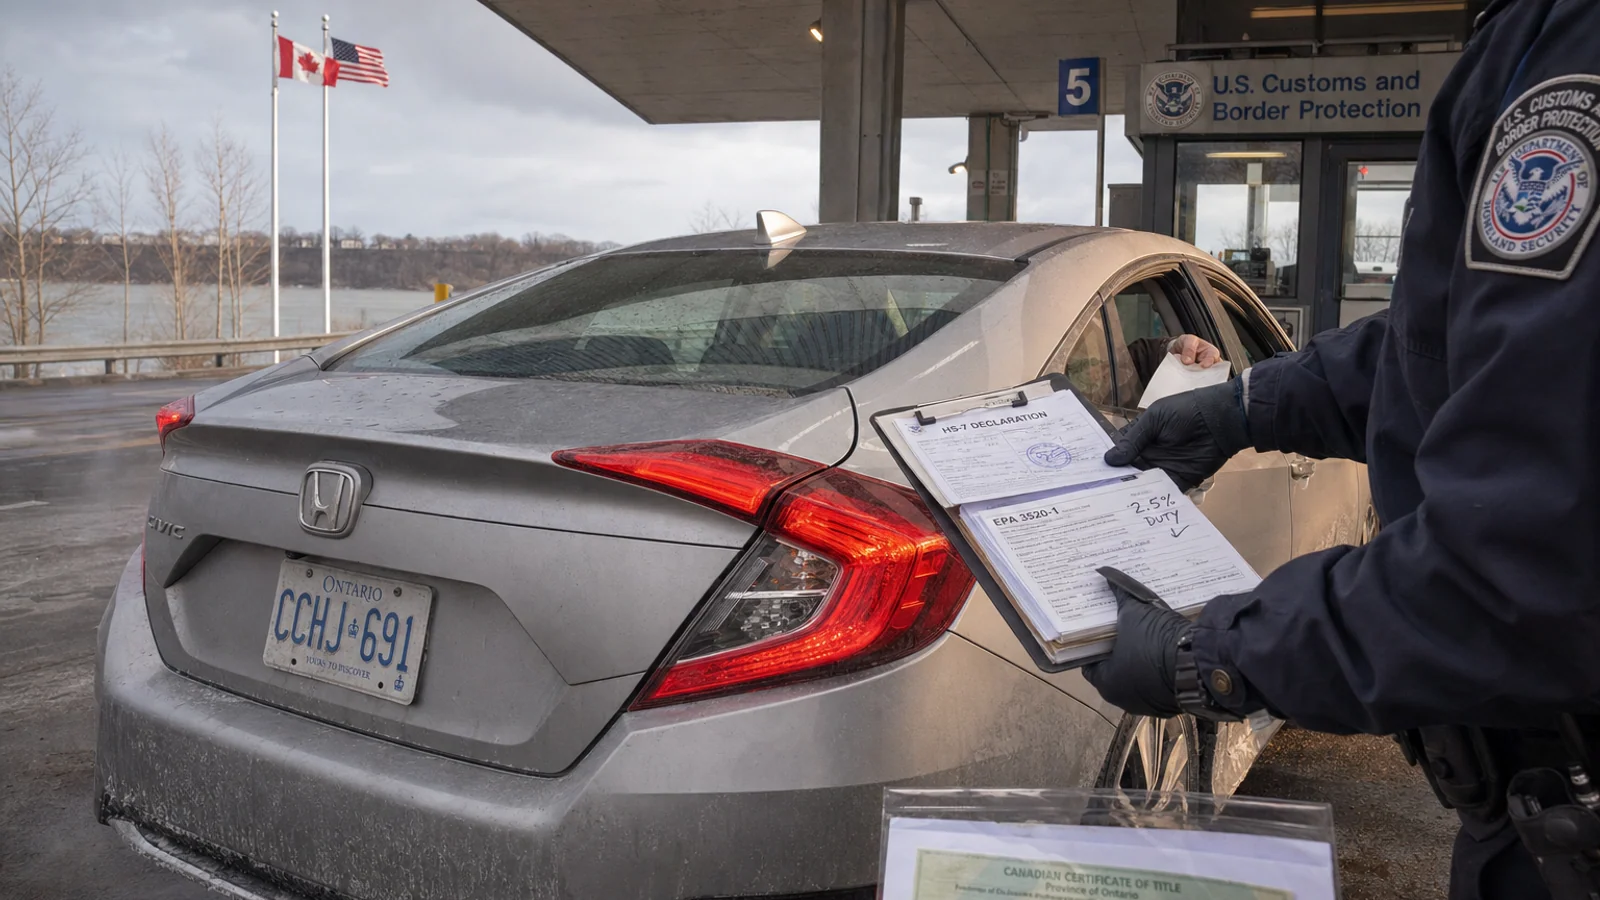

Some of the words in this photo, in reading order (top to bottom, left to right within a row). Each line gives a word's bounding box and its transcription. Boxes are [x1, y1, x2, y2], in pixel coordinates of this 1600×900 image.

[1066, 68, 1091, 106] 5
[1213, 75, 1254, 94] U.S.
[1262, 72, 1366, 93] Customs
[1375, 70, 1420, 91] and
[1213, 101, 1289, 121] Border
[1299, 98, 1421, 120] Protection
[1503, 108, 1525, 132] U.S.
[1529, 89, 1596, 113] CUSTOMS
[1496, 115, 1539, 156] BORDER
[1577, 171, 1589, 189] OF
[1520, 204, 1581, 252] SECURITY
[941, 422, 968, 434] HS-7
[971, 411, 1048, 430] DECLARATION
[1131, 493, 1176, 515] 2.5%
[148, 515, 185, 540] CIVIC
[992, 515, 1019, 527] EPA
[1019, 507, 1060, 522] 3520-1
[1144, 510, 1180, 526] DUTY
[274, 588, 347, 654] CCHJ
[359, 608, 414, 673] 691
[1003, 866, 1061, 881] CANADIAN
[1064, 872, 1132, 888] CERTIFICATE
[1135, 878, 1150, 890] OF
[1152, 880, 1181, 893] TITLE
[1045, 882, 1087, 895] Province
[1089, 885, 1100, 895] of
[1101, 887, 1139, 900] Ontario
